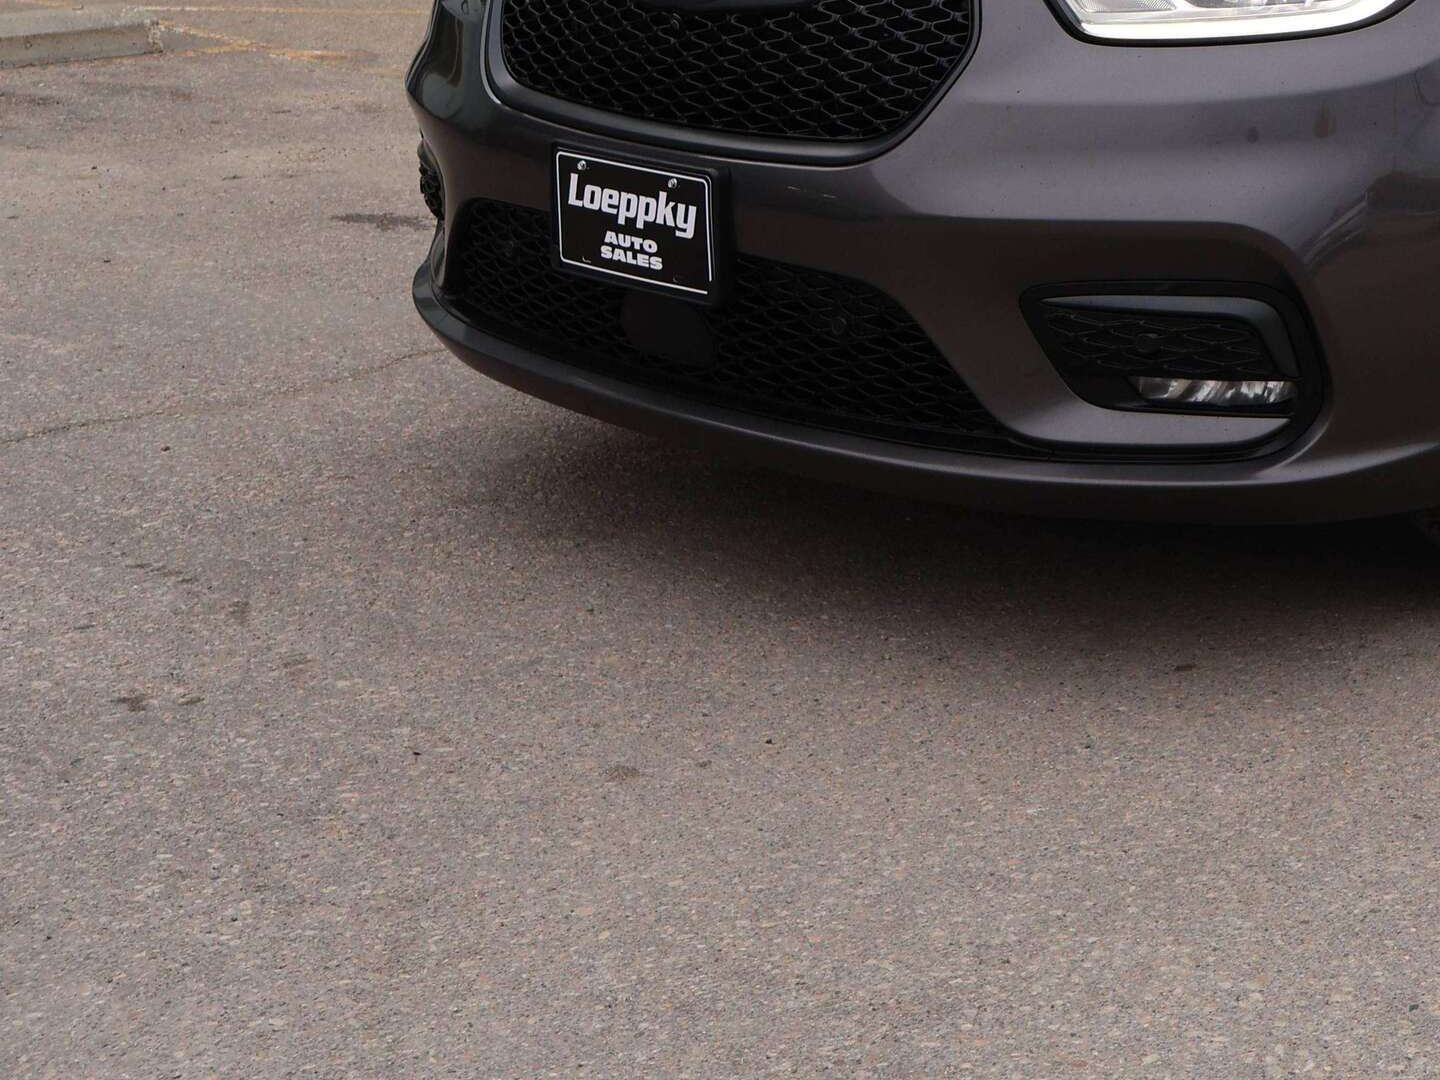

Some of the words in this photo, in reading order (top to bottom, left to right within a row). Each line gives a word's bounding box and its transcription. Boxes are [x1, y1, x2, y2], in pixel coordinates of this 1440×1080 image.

[567, 172, 697, 239] Loeppky
[604, 230, 658, 253] AUTO
[600, 245, 663, 271] SALES
